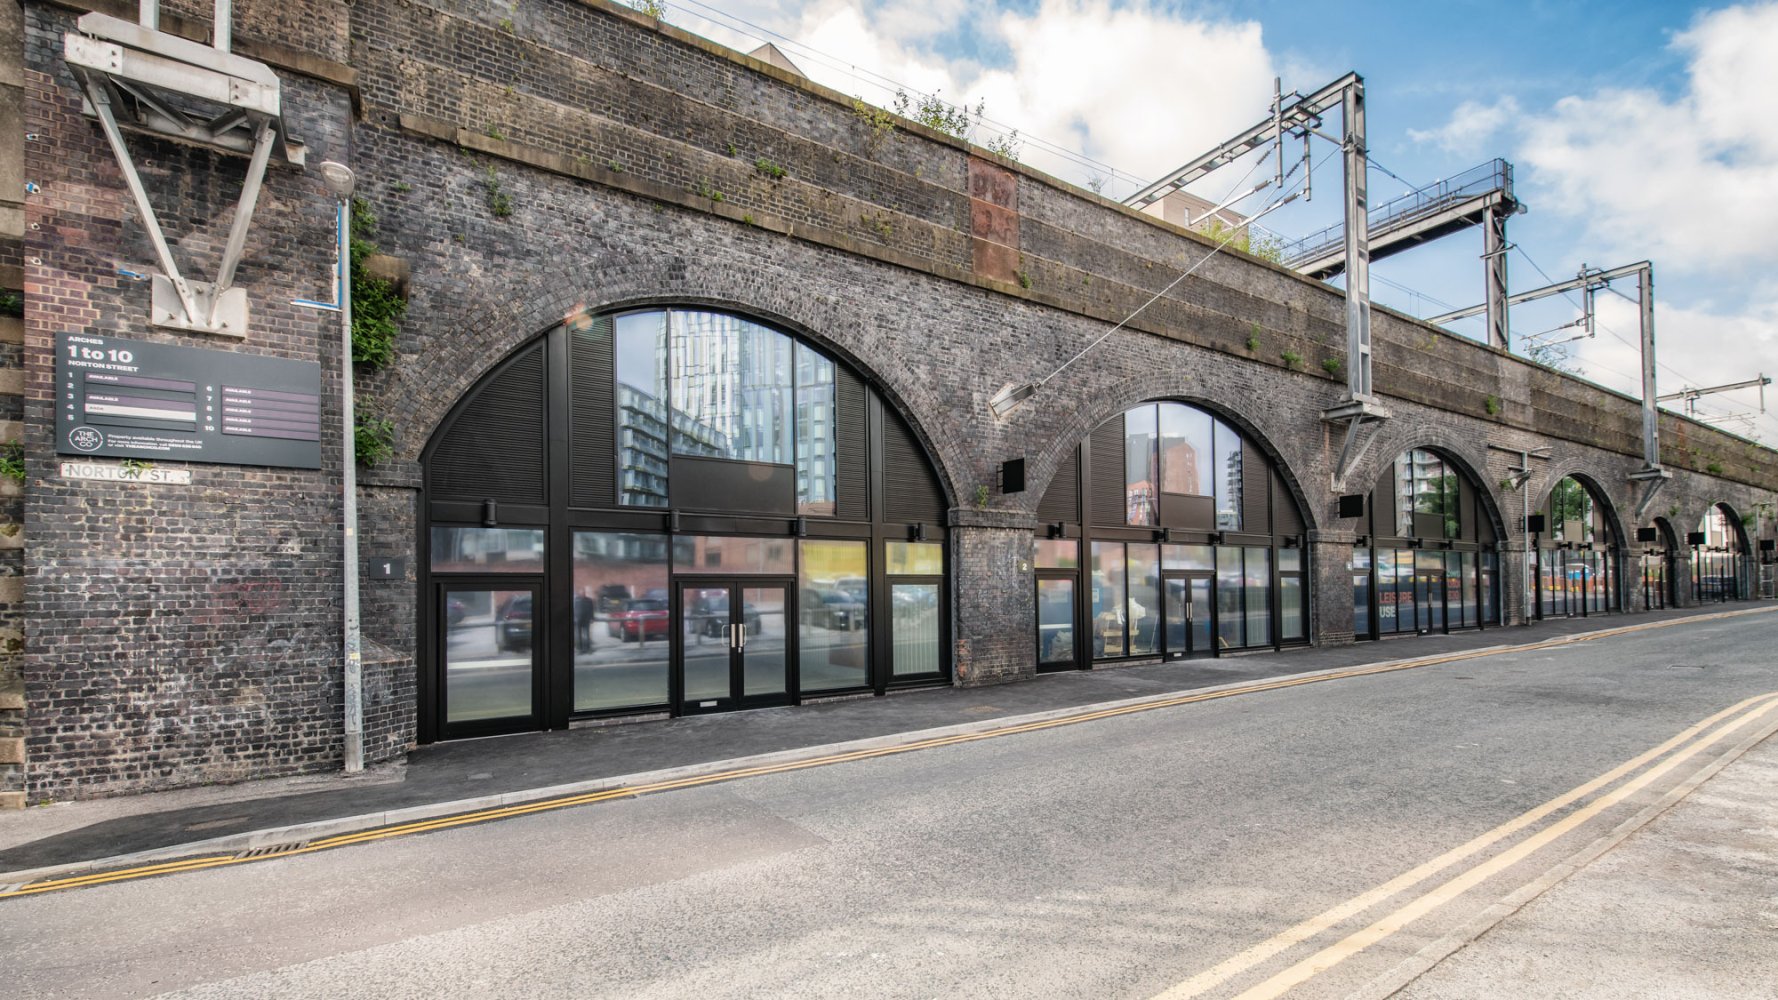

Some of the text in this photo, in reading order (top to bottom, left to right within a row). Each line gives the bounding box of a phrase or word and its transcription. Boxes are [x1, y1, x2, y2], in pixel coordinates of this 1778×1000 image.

[68, 336, 104, 344] ARCHES
[67, 345, 133, 363] 1 to 10
[68, 360, 139, 372] NORTON STREET
[69, 464, 142, 479] NORTON
[384, 563, 390, 574] 1
[1022, 562, 1027, 570] 2
[1379, 606, 1396, 618] USE
